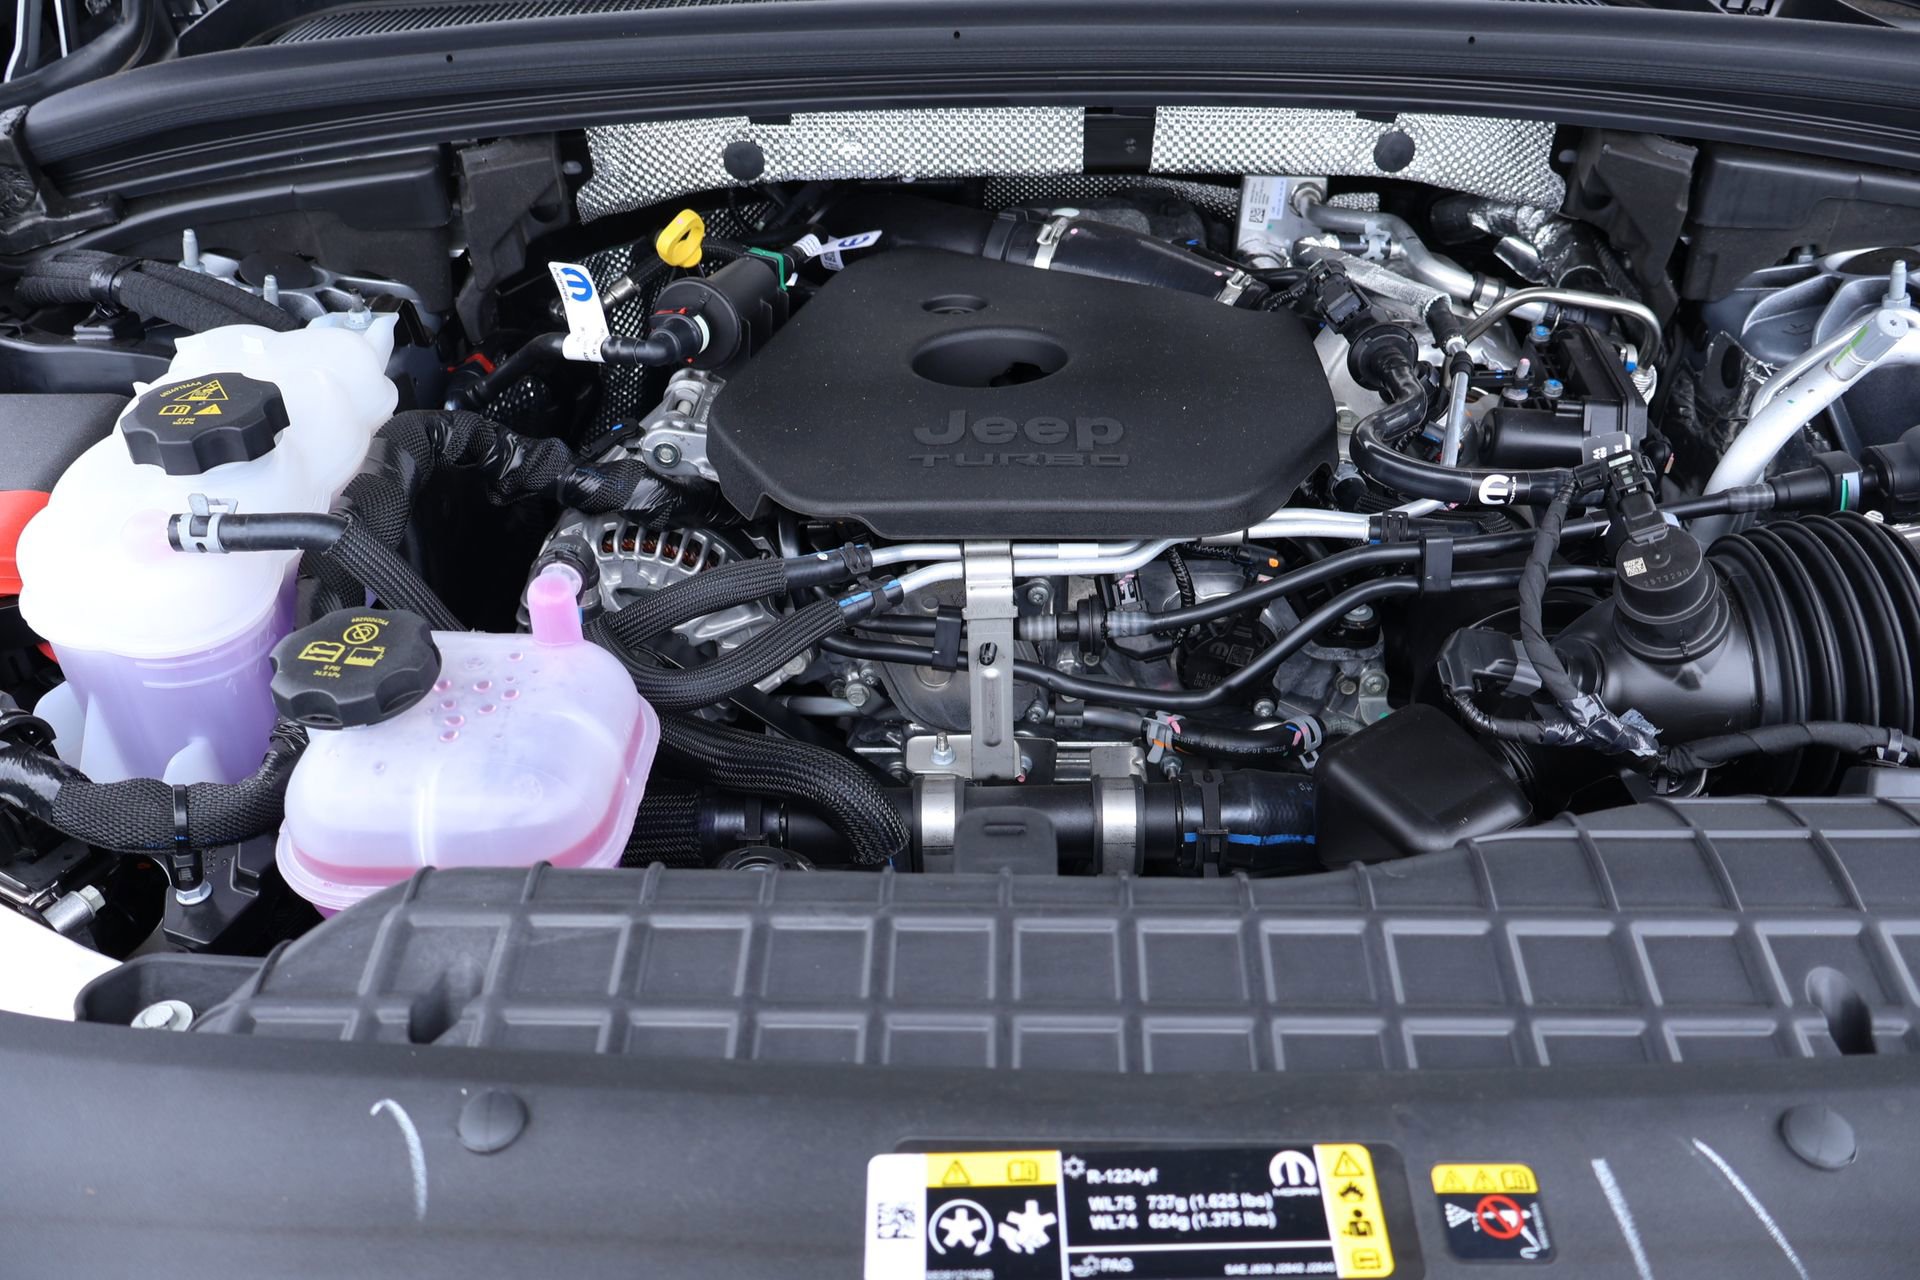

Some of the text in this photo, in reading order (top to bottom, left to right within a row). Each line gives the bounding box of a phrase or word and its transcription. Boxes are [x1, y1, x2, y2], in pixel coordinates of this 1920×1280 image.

[913, 409, 1124, 450] Jeep
[908, 453, 1130, 467] TURBO
[1086, 1167, 1158, 1187] R-1234yf
[1088, 1195, 1137, 1212] WL75
[1146, 1193, 1189, 1213] 737g
[1240, 1192, 1274, 1211] lbs)
[1089, 1210, 1277, 1232] WL74 624g (1.375 lbs)
[1100, 1257, 1135, 1272] PAG
[1224, 1263, 1248, 1275] SAE
